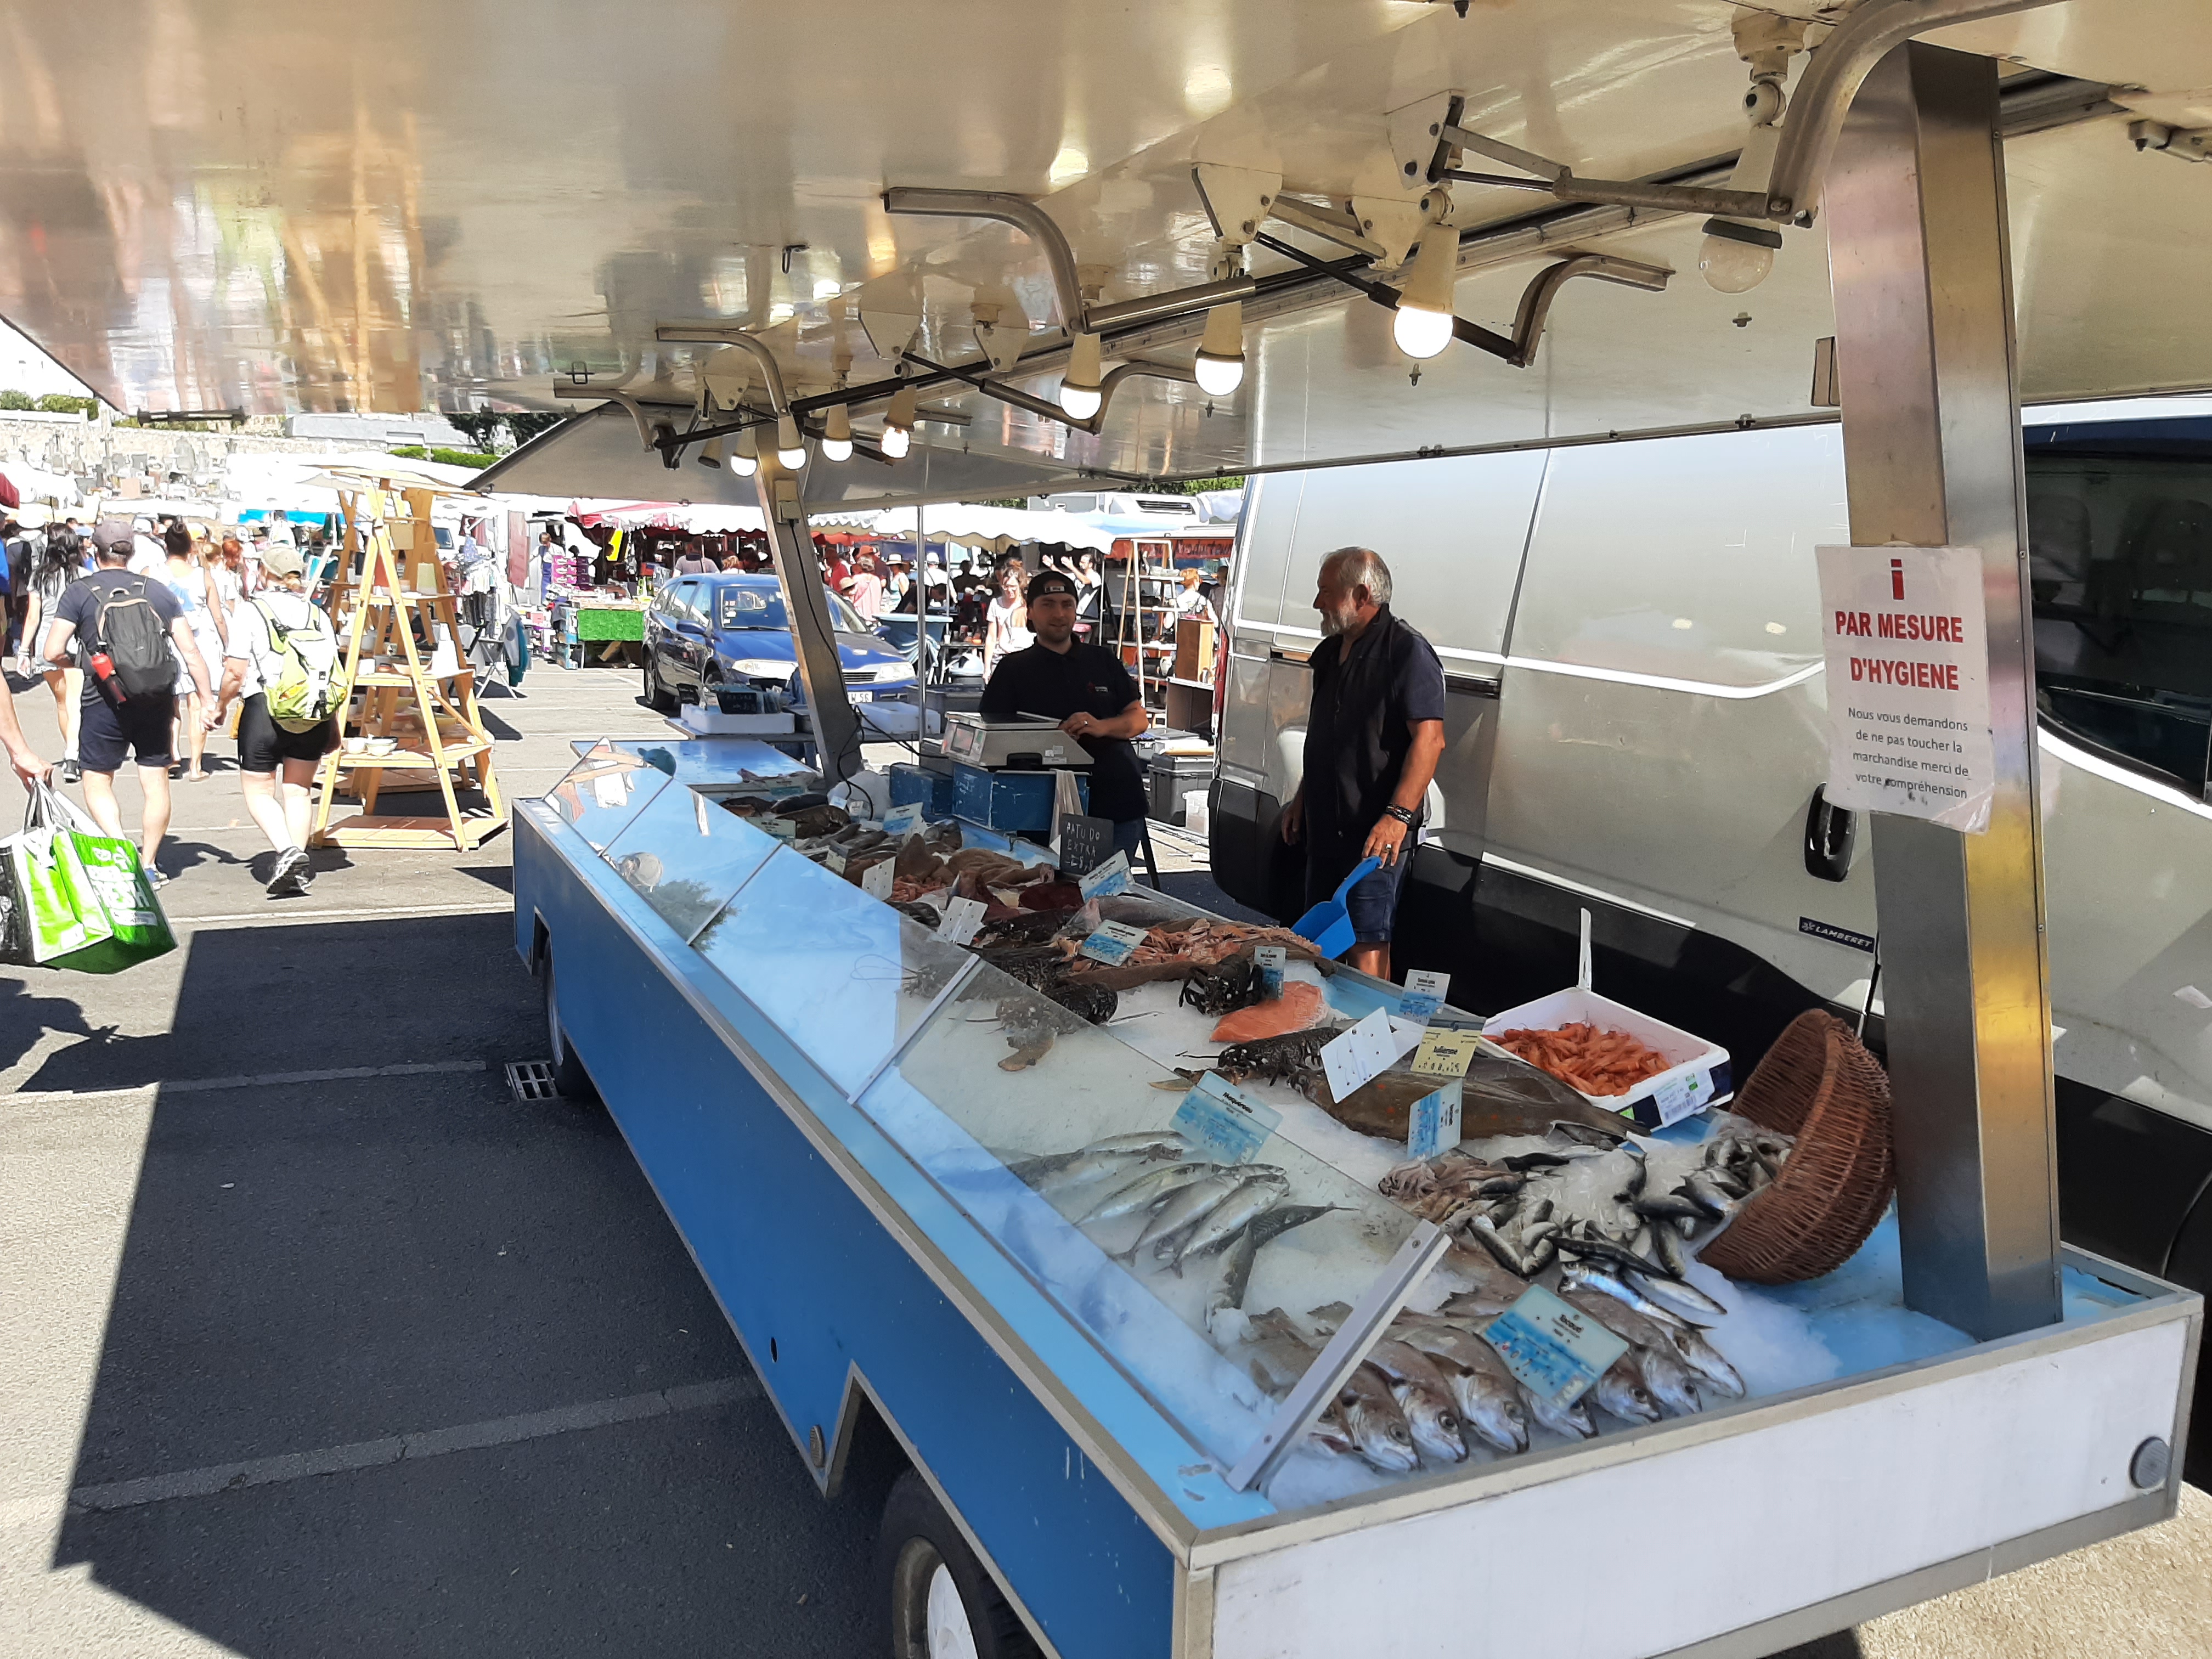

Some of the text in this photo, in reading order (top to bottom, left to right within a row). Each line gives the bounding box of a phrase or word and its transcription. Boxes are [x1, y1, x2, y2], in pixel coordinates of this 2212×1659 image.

[1835, 611, 1963, 642] PAR MESURE
[1850, 657, 1959, 690] D'HYGIENE
[1848, 707, 1968, 731] Nous vous demandons
[1856, 730, 1962, 753] de ne pas toucher la
[1853, 752, 1969, 777] marchandise merci de
[1855, 773, 1967, 799] votre compréhension
[1067, 839, 1096, 857] EXTRA
[1815, 926, 1872, 946] LAMBERET
